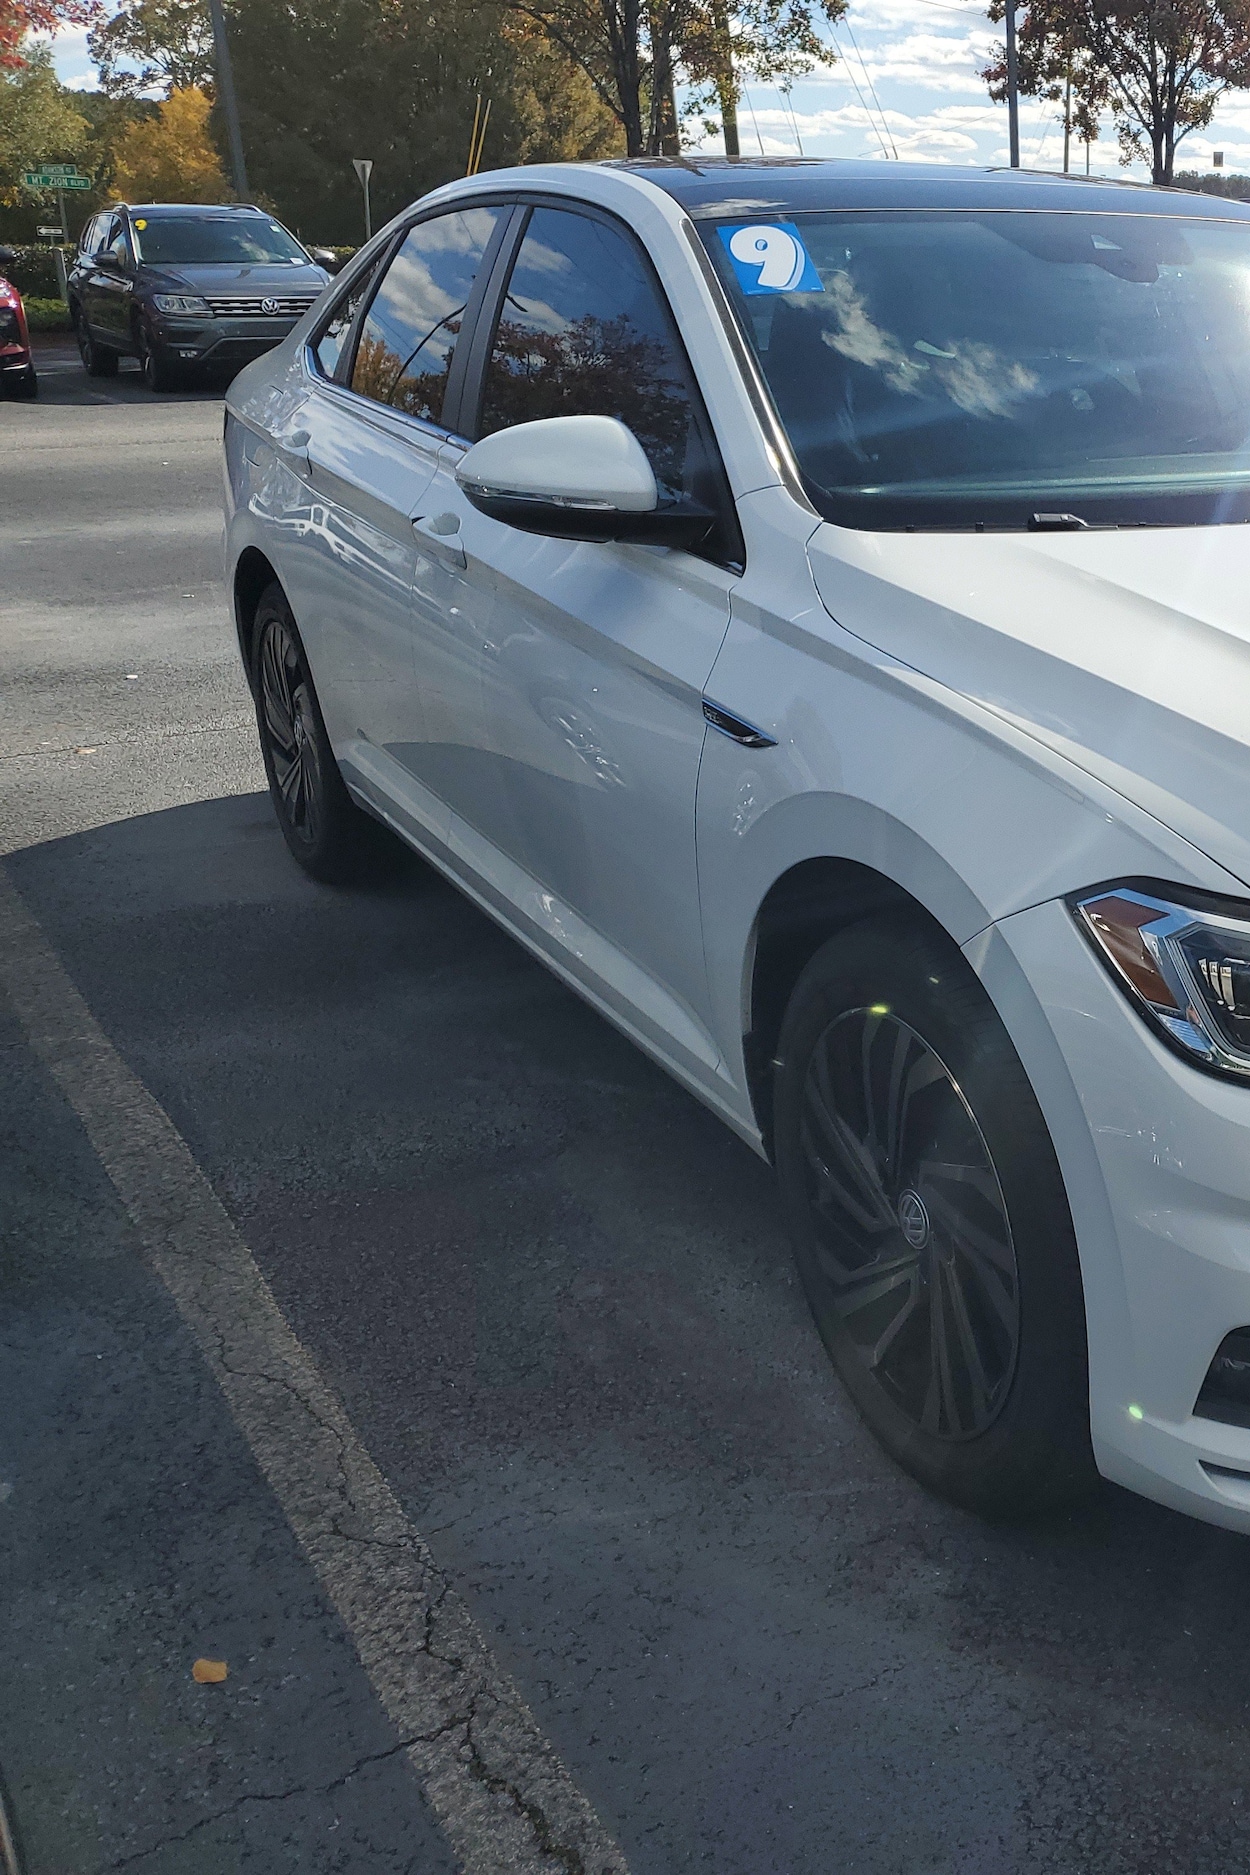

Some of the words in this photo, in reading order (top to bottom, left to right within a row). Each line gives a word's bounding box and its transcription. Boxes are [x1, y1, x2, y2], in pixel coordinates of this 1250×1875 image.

[49, 176, 68, 186] ZION
[70, 179, 85, 187] BLVD
[135, 219, 147, 231] 9
[729, 225, 805, 291] 9
